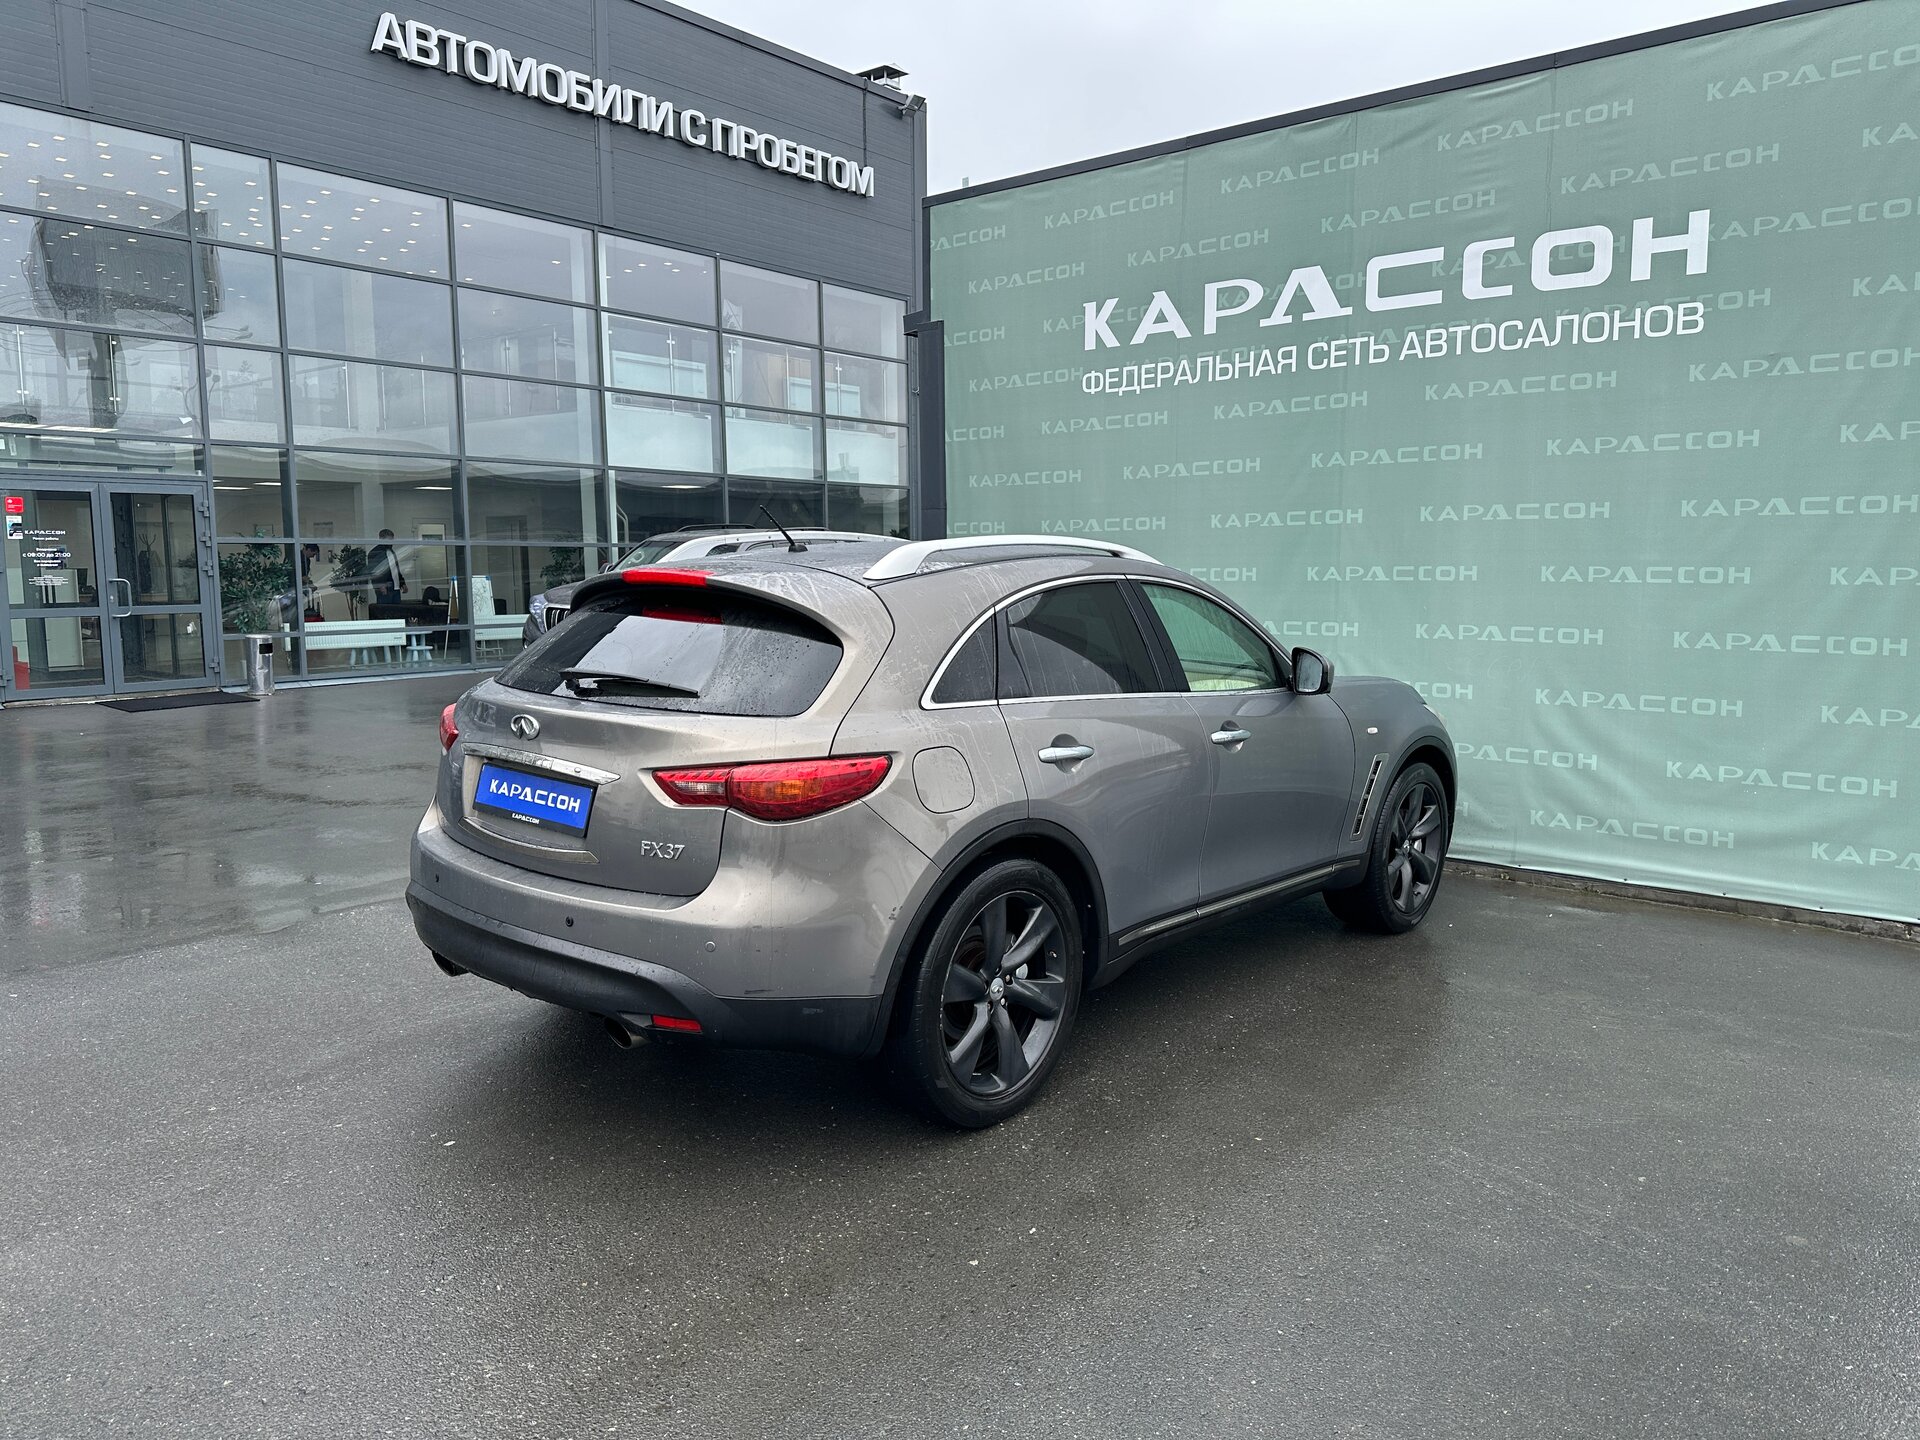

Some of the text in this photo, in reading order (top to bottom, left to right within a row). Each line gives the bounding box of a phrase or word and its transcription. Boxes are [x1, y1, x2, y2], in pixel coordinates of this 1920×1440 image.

[370, 12, 875, 198] АВТОМОБИЛИ С ПРОБЕГОМ
[1083, 208, 1711, 351] КАРАССОН
[1082, 301, 1705, 396] ФЕДЕРАЛЬНАЯ СЕТЬ АВТОСАЛОНОВ
[640, 840, 685, 861] FX37
